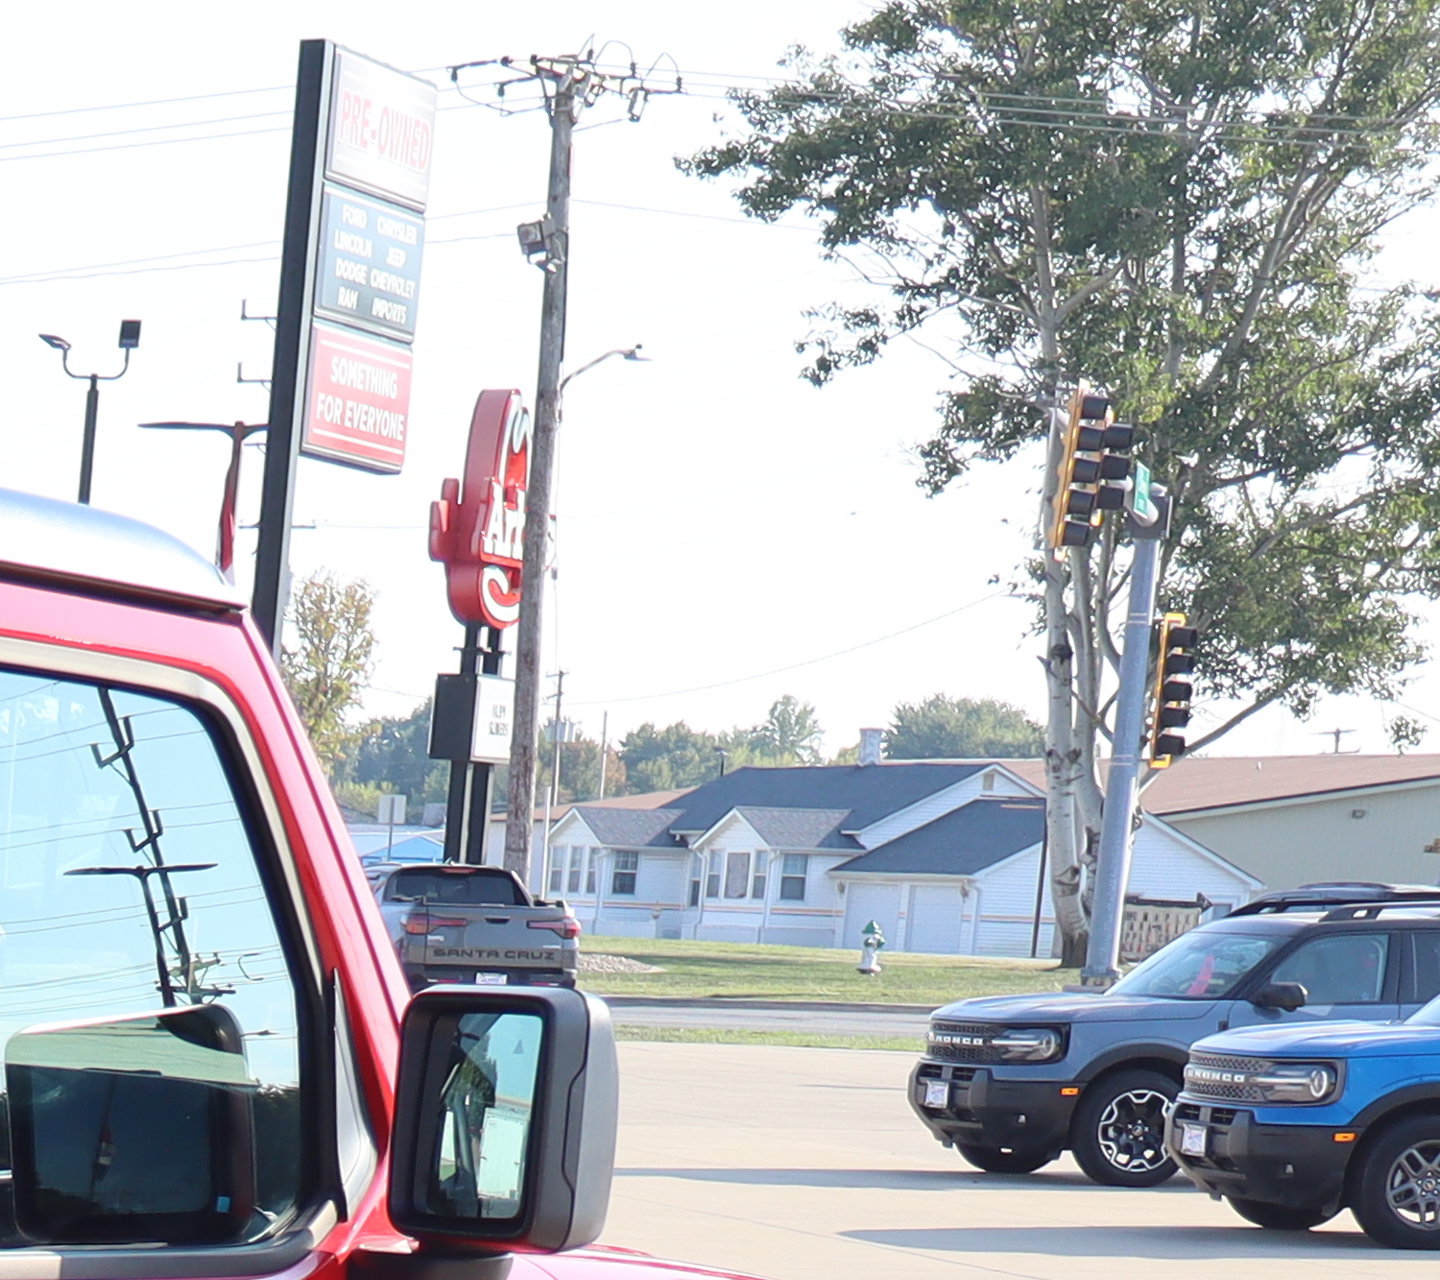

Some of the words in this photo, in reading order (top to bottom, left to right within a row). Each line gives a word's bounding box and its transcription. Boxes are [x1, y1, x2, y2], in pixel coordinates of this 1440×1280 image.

[338, 90, 430, 171] PRE-OWNED
[342, 204, 367, 229] FORD
[376, 215, 418, 245] CHRYSLER
[334, 229, 373, 259] LINCOLN
[385, 246, 406, 268] JEEP
[335, 257, 368, 285] DODGE
[369, 267, 416, 299] CHEVROLET
[337, 286, 358, 310] RAM
[371, 296, 408, 324] IMPORTS
[330, 355, 398, 400] SOMETHING
[316, 392, 343, 425] FOR
[344, 400, 405, 441] EVERYONE
[433, 949, 500, 961] SANTA
[504, 950, 556, 961] CRUZ
